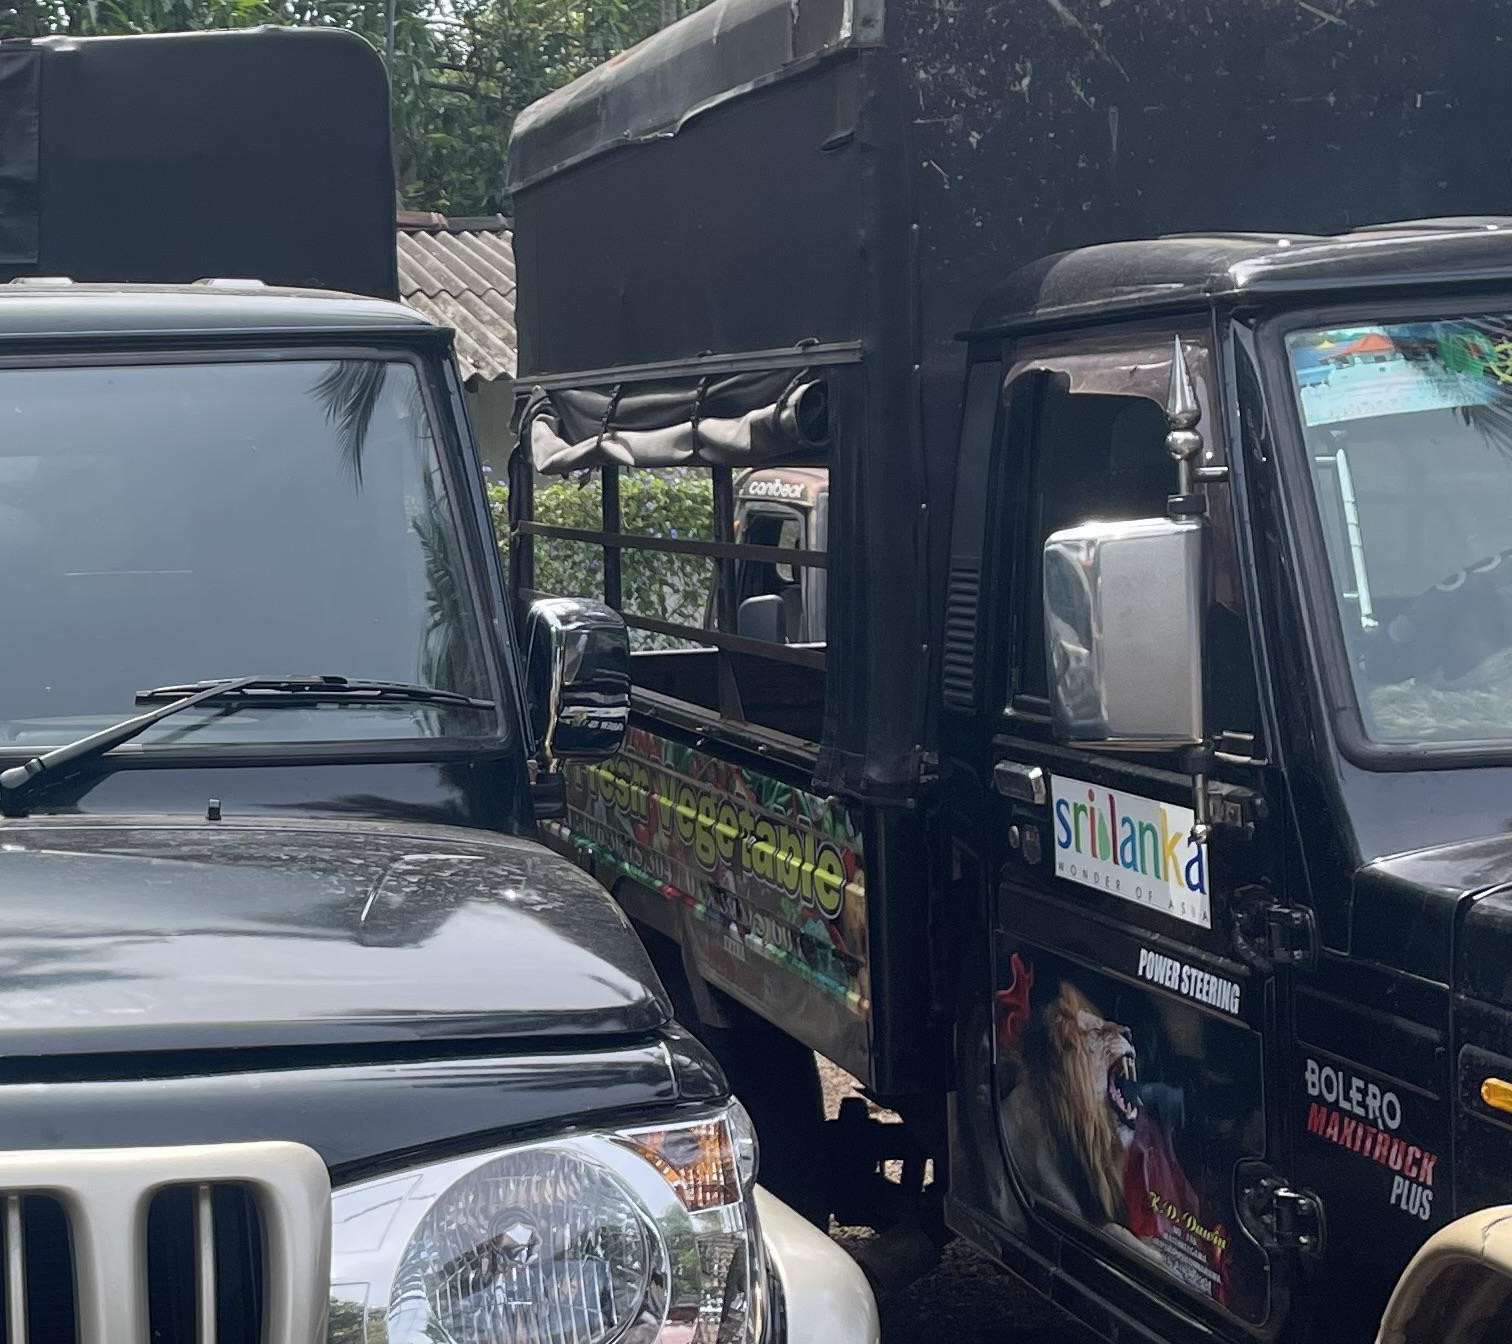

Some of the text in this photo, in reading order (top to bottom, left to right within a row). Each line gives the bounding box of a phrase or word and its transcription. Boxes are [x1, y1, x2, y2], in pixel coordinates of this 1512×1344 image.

[657, 771, 847, 920] Vegetable
[1058, 861, 1209, 922] WONDER OF ASIA
[1138, 948, 1241, 1015] POWER STEERING
[1304, 1058, 1402, 1130] BOLERO
[1307, 1102, 1438, 1186] MAXITRUCK
[1390, 1175, 1434, 1221] PLUS
